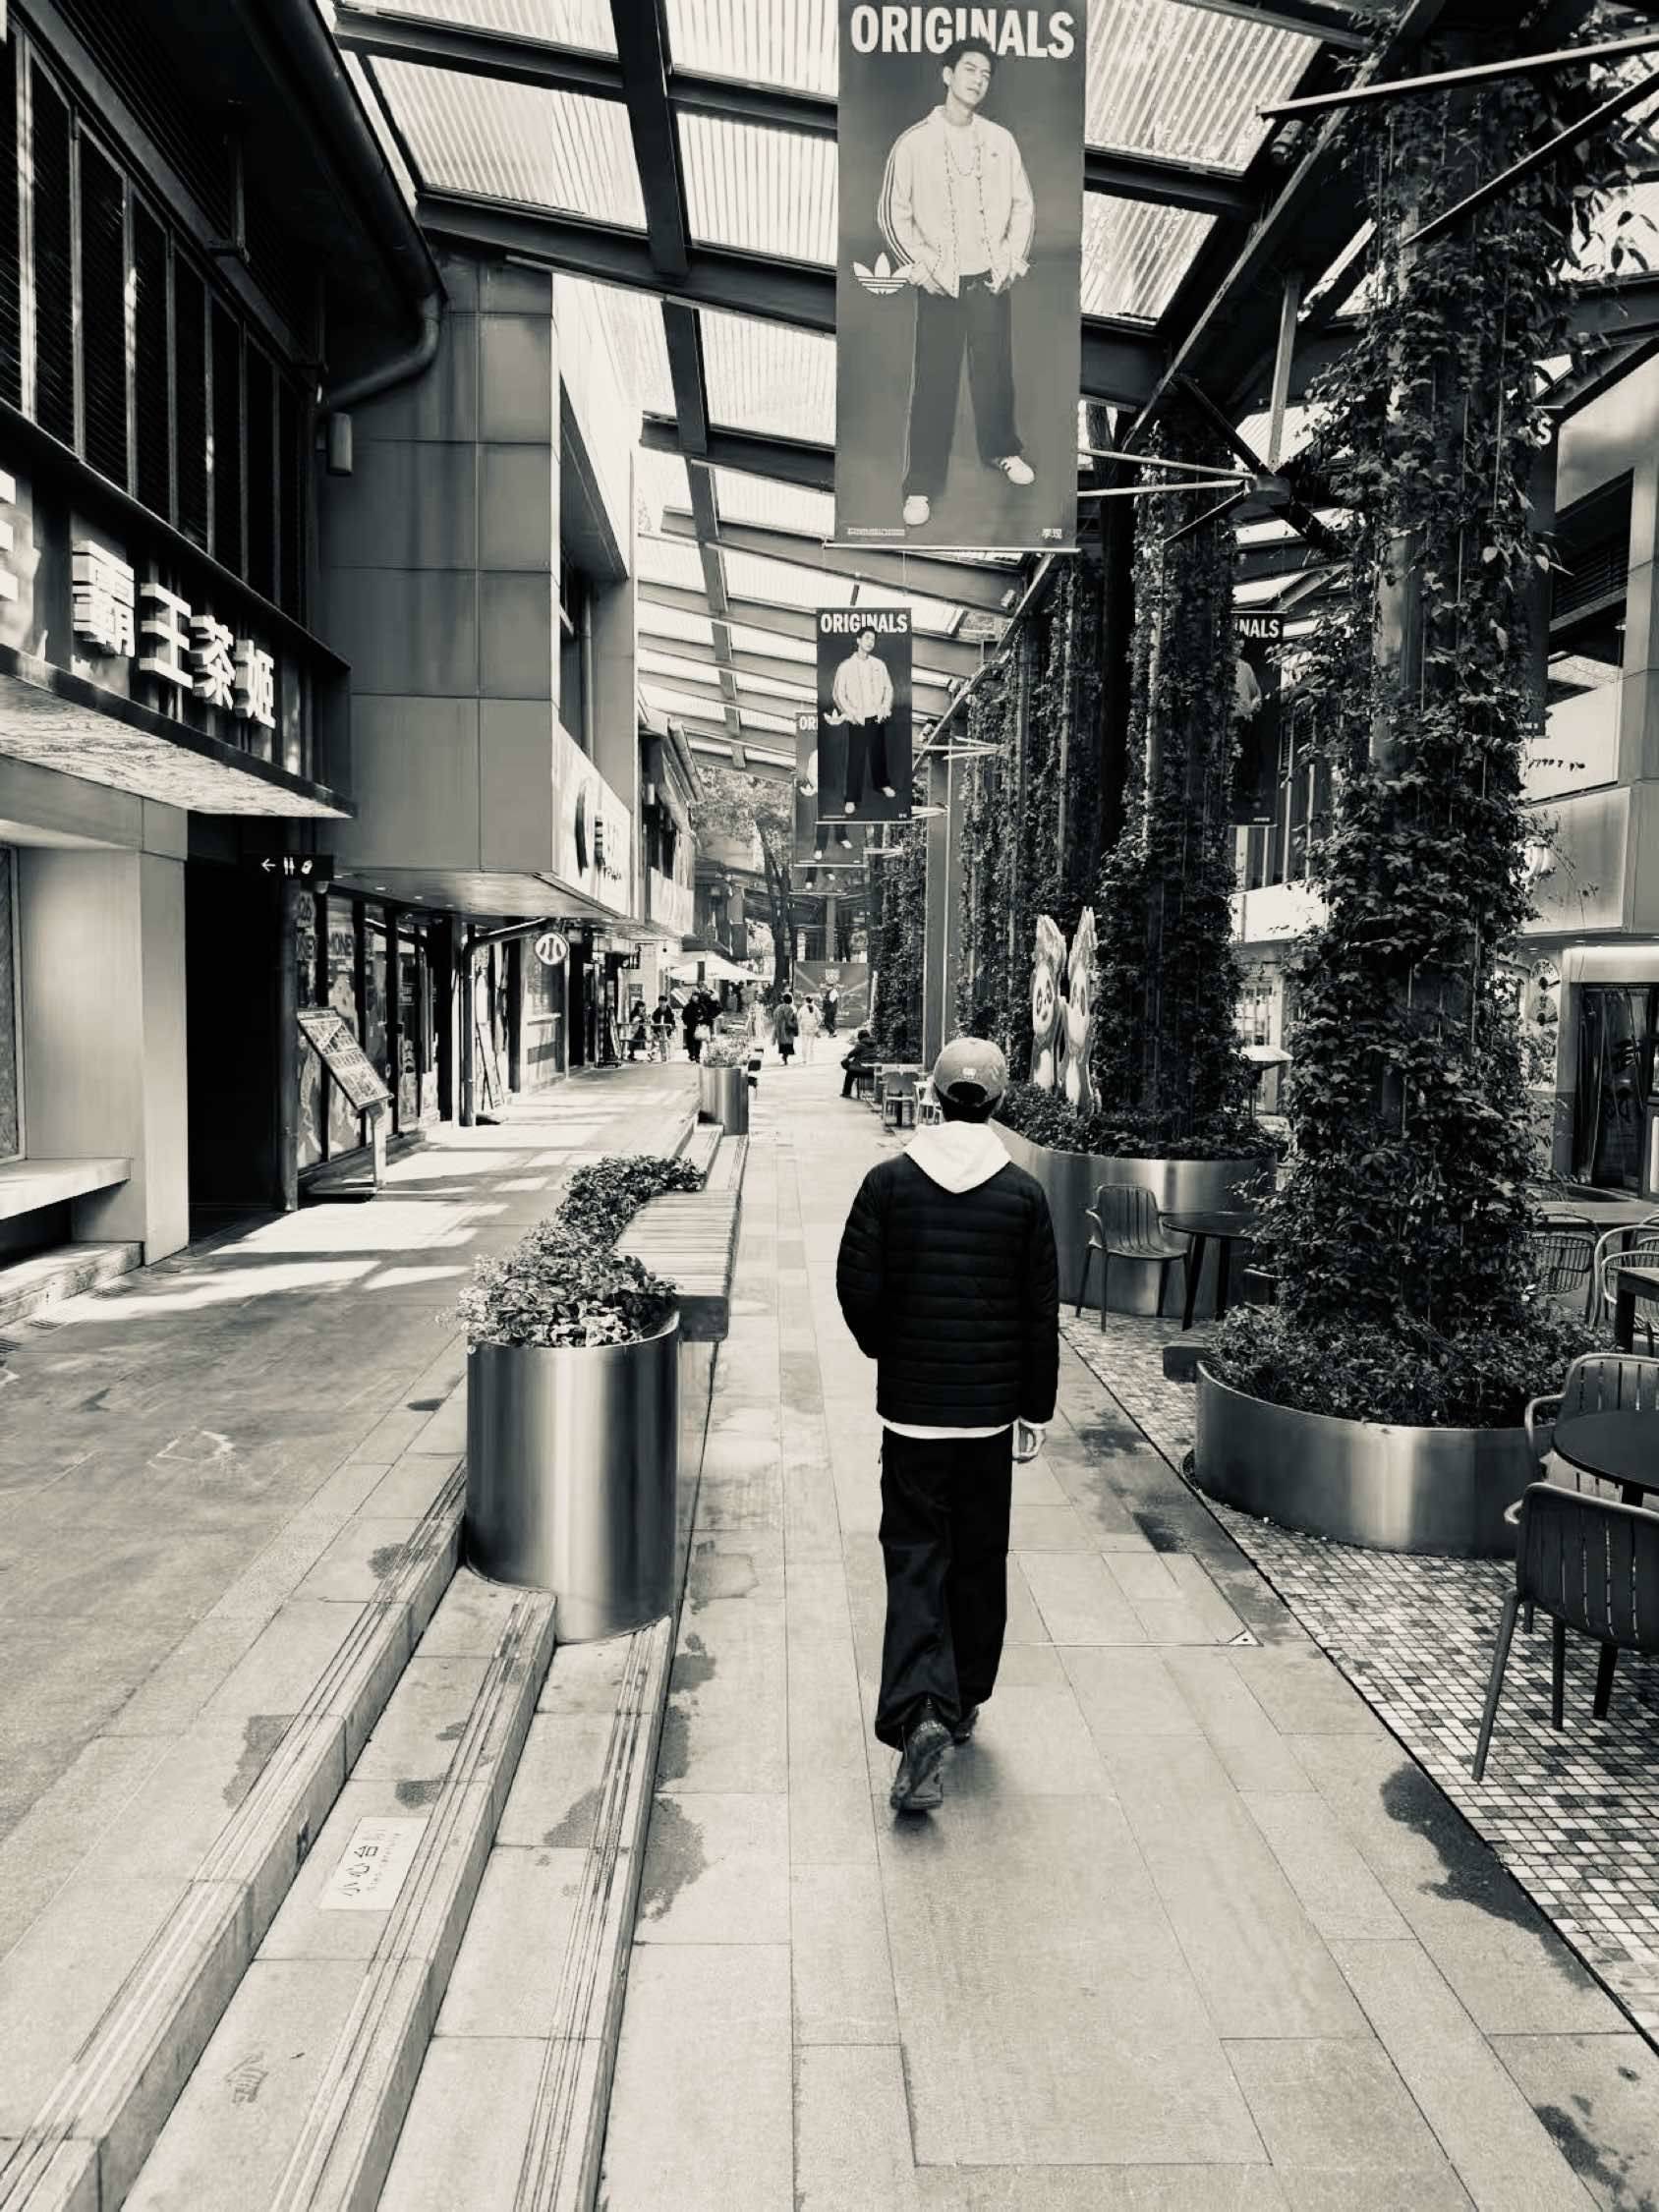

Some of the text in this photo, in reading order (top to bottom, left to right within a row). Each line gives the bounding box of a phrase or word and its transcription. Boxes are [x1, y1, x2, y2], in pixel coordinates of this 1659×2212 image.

[850, 4, 1075, 59] ORIGINALS
[72, 539, 276, 729] 霸王茶姬
[821, 613, 908, 633] ORIGINALS
[338, 1829, 386, 1897] 小心台
